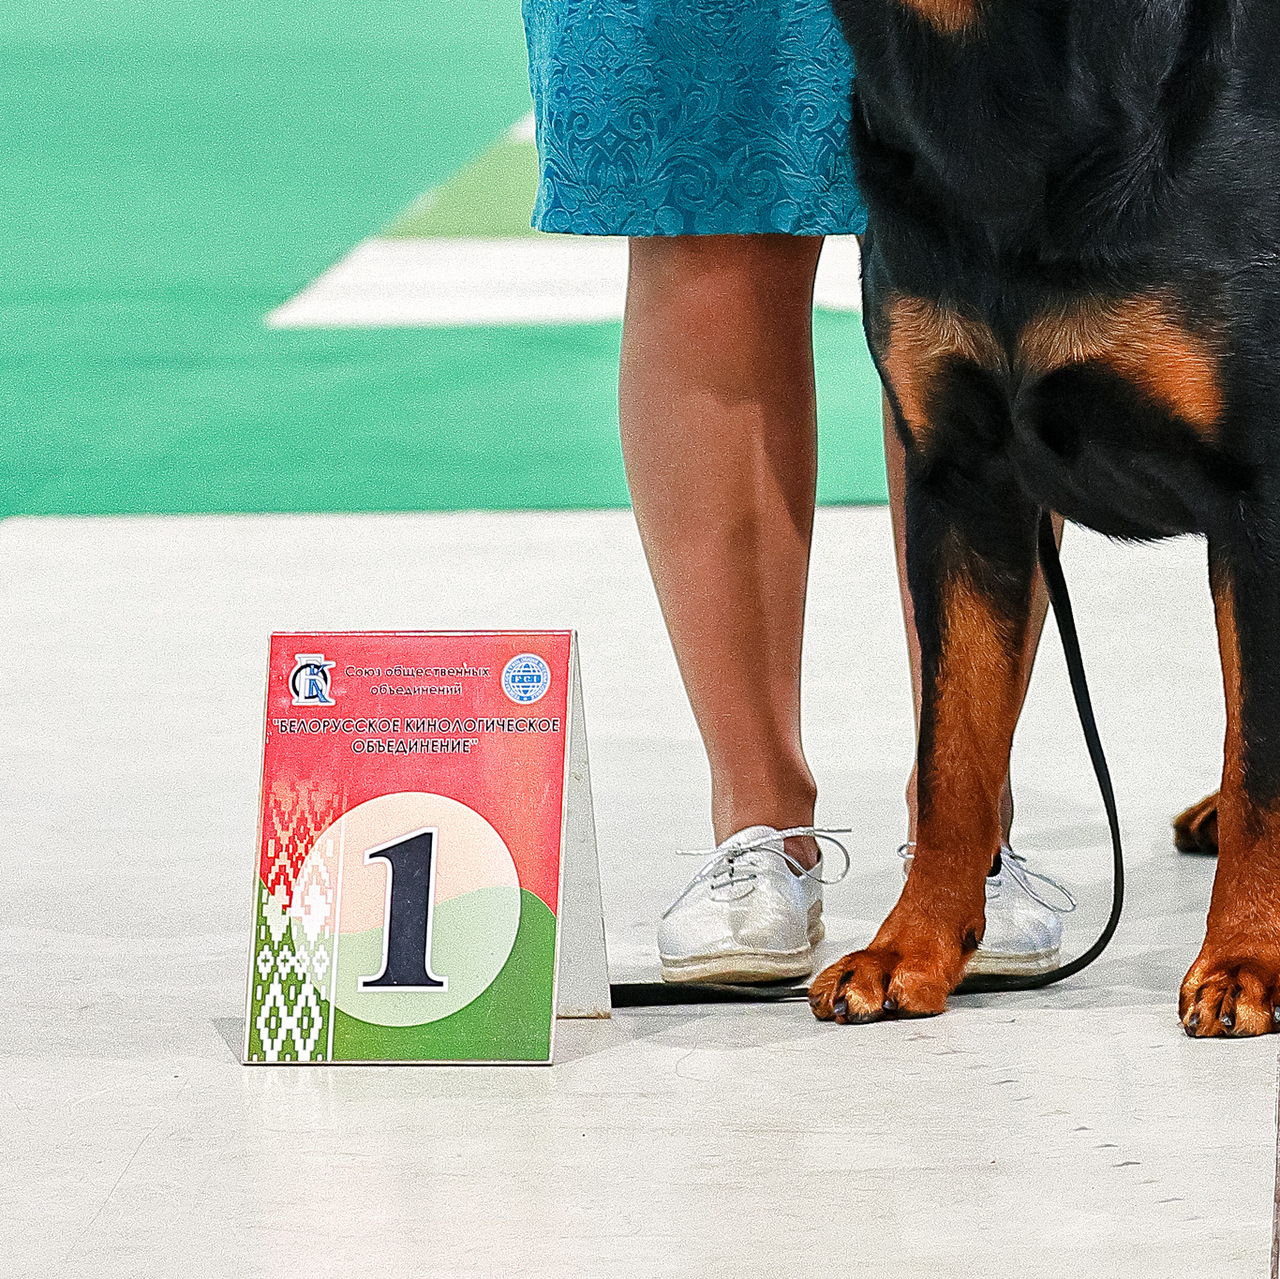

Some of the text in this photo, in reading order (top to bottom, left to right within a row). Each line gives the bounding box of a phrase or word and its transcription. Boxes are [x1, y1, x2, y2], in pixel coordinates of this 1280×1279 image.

[385, 665, 490, 678] общественных
[370, 683, 462, 696] объединений
[273, 718, 560, 733] "БЕЛОРУССКОЕ КИНОЛОГИЧЕСКОЕ
[352, 738, 478, 754] ОБЪЕДИНЕНИЕ"
[361, 829, 446, 989] 1
